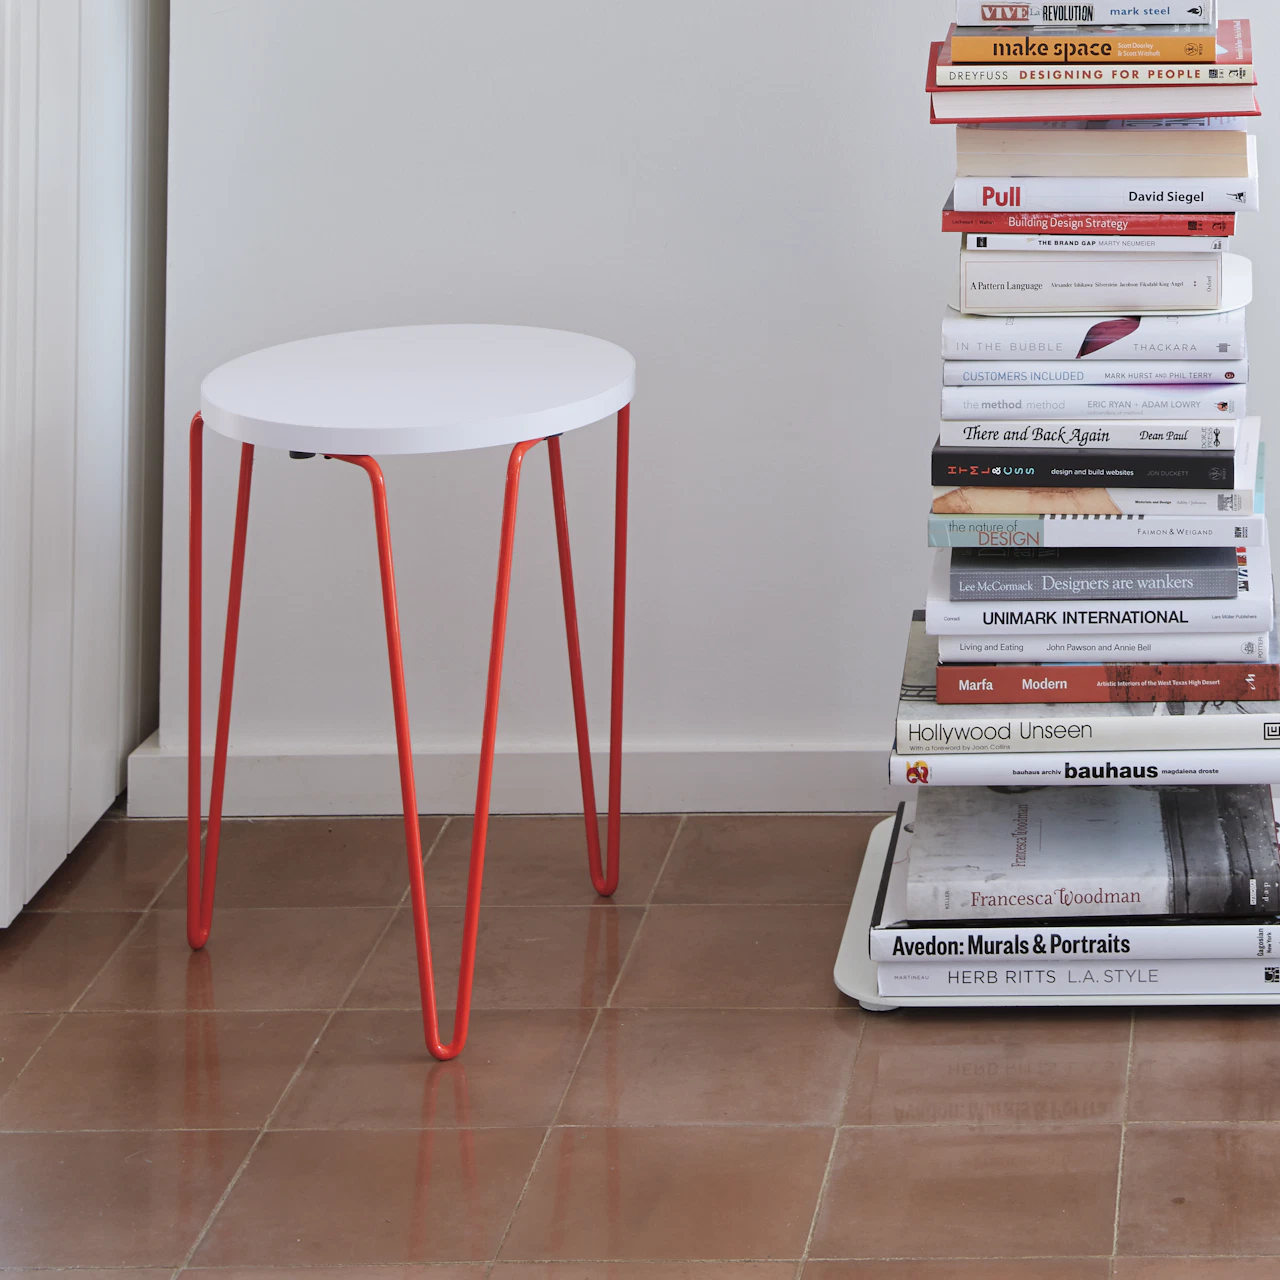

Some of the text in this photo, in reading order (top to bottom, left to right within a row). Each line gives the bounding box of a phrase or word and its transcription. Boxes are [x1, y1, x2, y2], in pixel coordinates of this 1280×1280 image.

[1043, 5, 1093, 22] REVOLUTION
[1110, 7, 1170, 16] mark steel
[993, 37, 1112, 63] make space
[950, 69, 1200, 80] DREYFUSS DESIGNING FOR PEOPLE
[982, 186, 1204, 207] Pull David Siegel
[1008, 217, 1128, 230] Building Design Strategy
[970, 282, 1043, 291] A Pattern Language
[963, 371, 1084, 381] CUSTOMERS INCLUDED
[963, 426, 1110, 447] There and Back Again
[978, 531, 1039, 546] DESIGN
[959, 581, 1033, 591] Lee McCormack
[1042, 575, 1193, 592] Designers are wankers
[983, 610, 1188, 625] UNIMARK INTERNATIONAL
[960, 643, 1024, 653] Living and Eating
[958, 678, 1067, 691] Marfa Modern
[909, 722, 1092, 744] Hollywood Unseen
[1064, 762, 1158, 779] bauhaus
[893, 934, 1130, 956] Avedon: Murals & Portraits
[948, 970, 998, 984] HERB
[1006, 970, 1056, 984] RITTS
[1068, 969, 1098, 983] L.A.
[1104, 969, 1158, 982] STYLE
